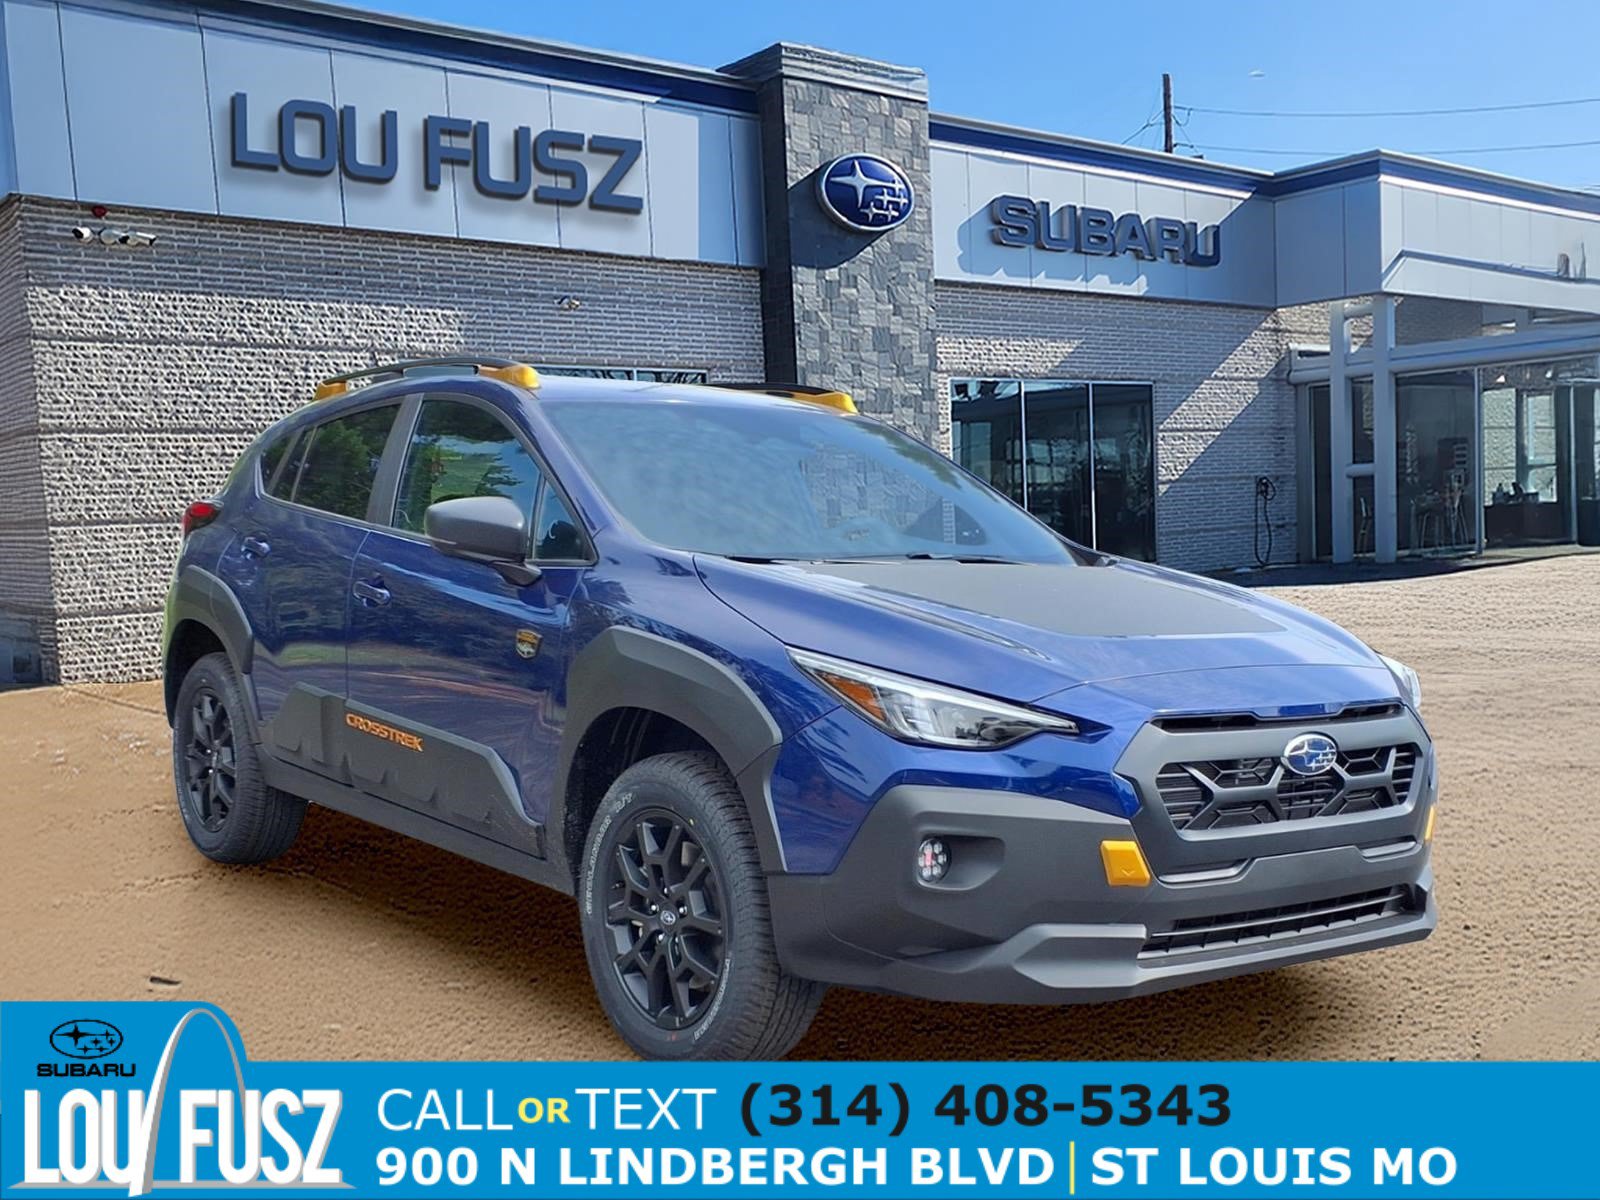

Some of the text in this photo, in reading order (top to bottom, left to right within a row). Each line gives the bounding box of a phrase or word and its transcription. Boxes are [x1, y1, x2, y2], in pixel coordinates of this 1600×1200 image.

[231, 92, 643, 211] LOU FUSZ
[992, 194, 1221, 267] SUBARU
[345, 713, 424, 752] CROSSTREK
